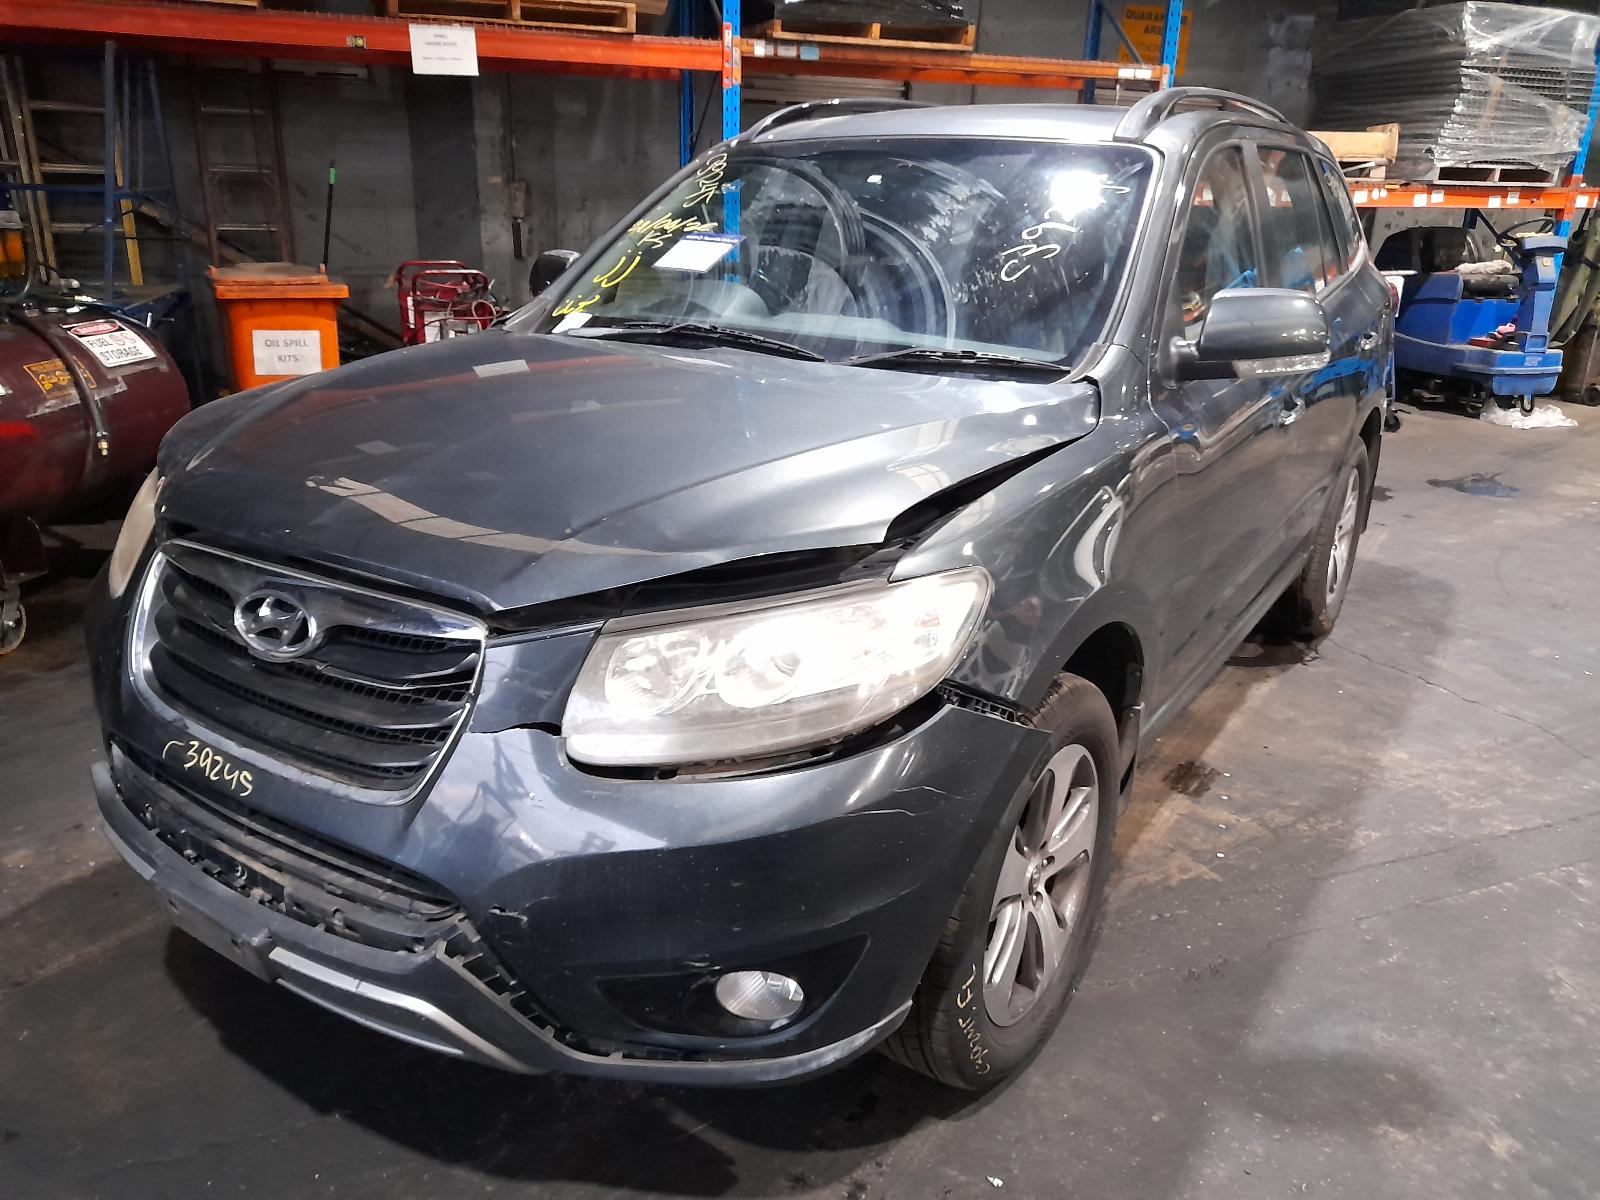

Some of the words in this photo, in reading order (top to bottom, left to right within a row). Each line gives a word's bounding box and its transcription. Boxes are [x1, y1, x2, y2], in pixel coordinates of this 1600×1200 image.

[86, 337, 113, 348] FUEL
[264, 339, 281, 347] OIL
[283, 339, 309, 347] SPILL
[99, 345, 143, 361] STORAGE
[277, 354, 299, 362] KITS
